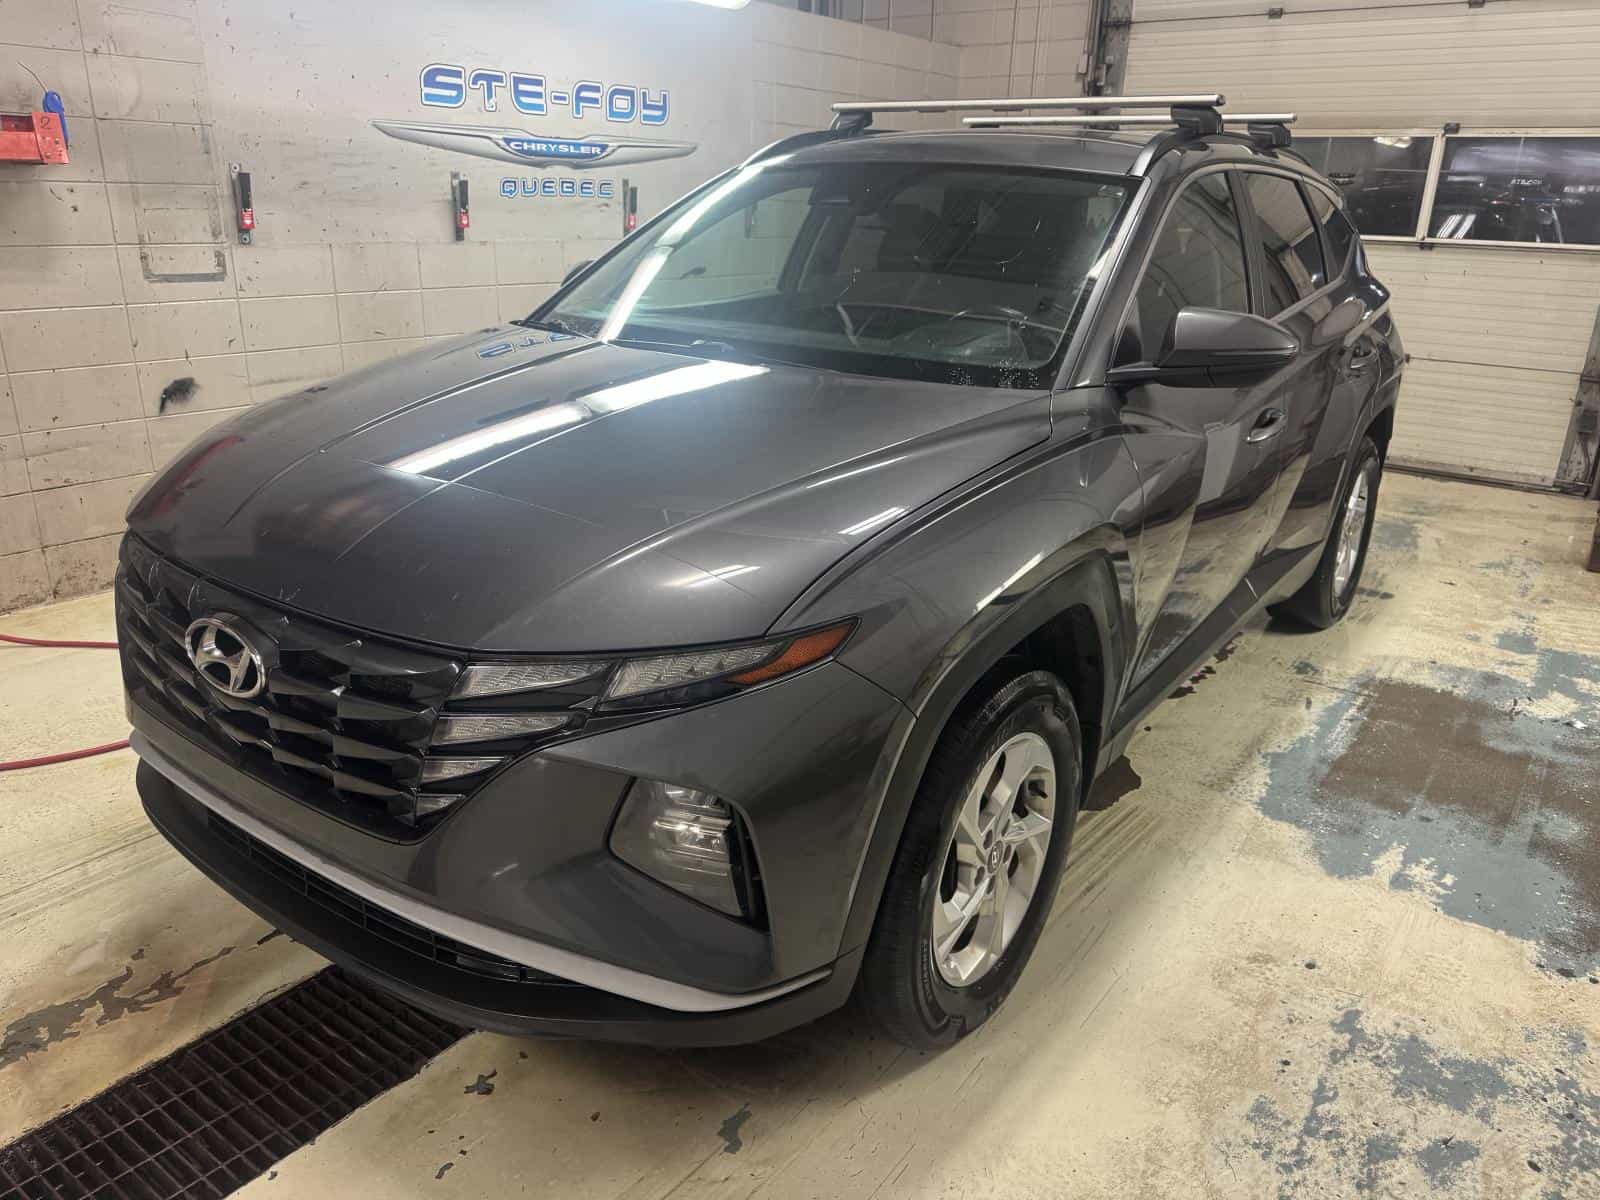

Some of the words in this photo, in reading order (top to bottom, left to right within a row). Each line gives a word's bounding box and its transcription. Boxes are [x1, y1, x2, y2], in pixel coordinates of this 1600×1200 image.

[420, 63, 669, 125] STE-FOY
[509, 141, 602, 155] CHRYSLER
[500, 177, 615, 199] QUEBEC
